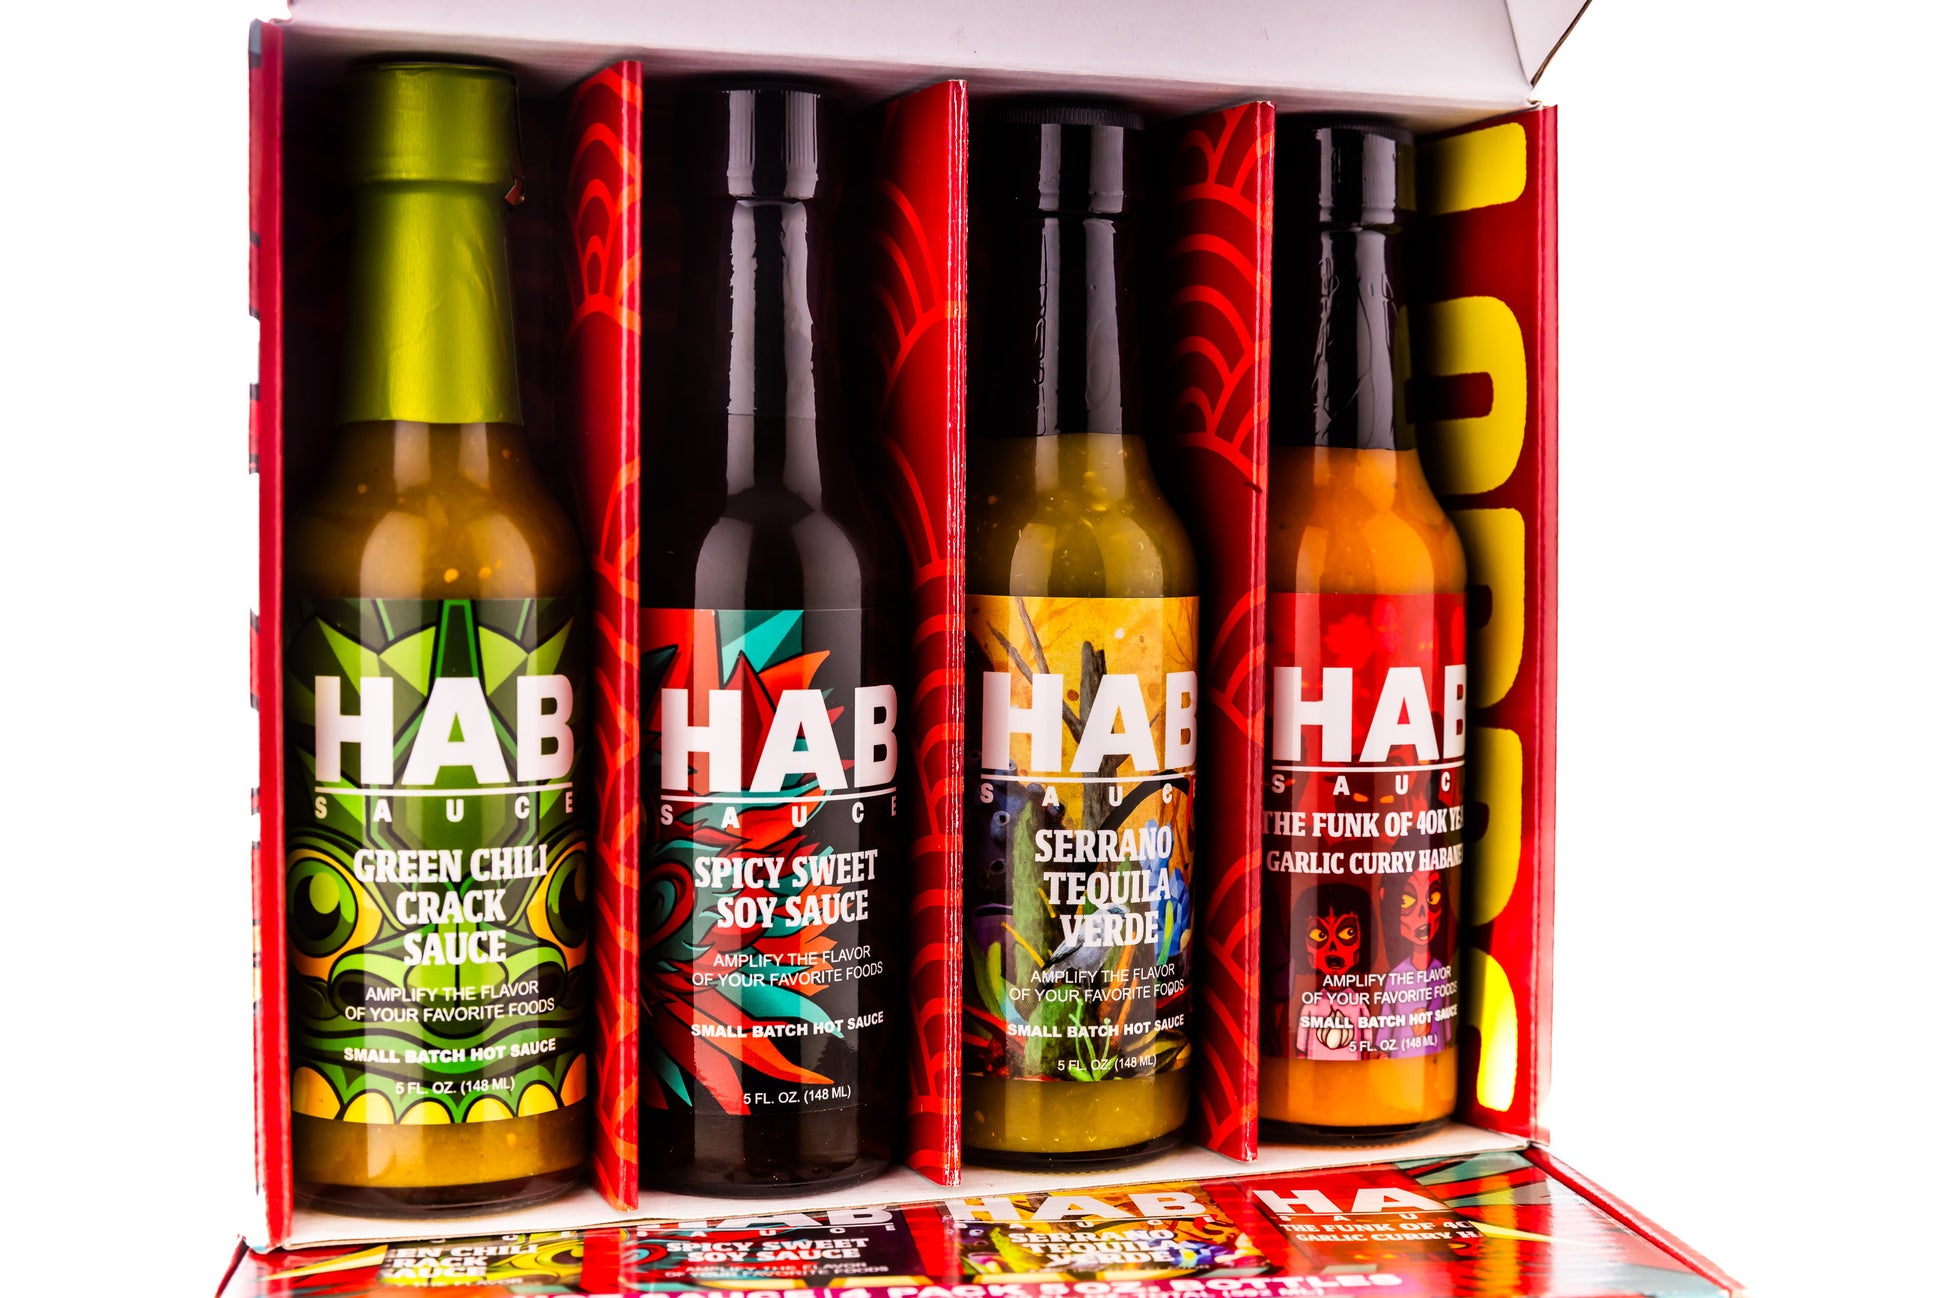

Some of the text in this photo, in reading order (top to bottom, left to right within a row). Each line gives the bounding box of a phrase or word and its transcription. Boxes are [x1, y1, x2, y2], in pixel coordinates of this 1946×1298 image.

[315, 674, 574, 785] HAB
[981, 670, 1198, 773] HAB
[661, 684, 898, 792] HAB
[315, 791, 573, 822] SAUCE
[980, 782, 1196, 807] SAUC
[661, 796, 896, 829] SAUCE
[1312, 812, 1380, 838] FUNK
[1385, 811, 1413, 837] OF
[1416, 808, 1448, 835] 40K
[1035, 825, 1172, 863] SERRANO
[353, 844, 548, 883] GREEN CHILI
[694, 849, 878, 888] SPICY SWEET
[1266, 851, 1344, 875] GARLIC
[1350, 851, 1416, 875] CURRY
[1043, 868, 1171, 906] TEQUILA
[396, 889, 507, 925] CRACK
[717, 889, 869, 928] SOY SAUCE
[1060, 911, 1159, 947] VERDE
[403, 930, 507, 967] SAUCE
[713, 945, 871, 968] AMPLIFY THE FLAVOR
[692, 961, 883, 987] OF YOUR FAVORITE FOODS
[1030, 963, 1175, 984] AMPLIFY THE FLAVOR
[1323, 965, 1452, 988] AMPLIFY THE FLAVOR
[365, 980, 539, 1002] AMPLIFY THE FLAVOR
[1009, 978, 1184, 1003] OF YOUR FAVORITE FOODS
[1302, 992, 1322, 1004] OF
[1326, 993, 1370, 1006] YOUR
[1374, 987, 1432, 1004] FAVORITE
[345, 998, 555, 1022] OF YOUR FAVORITE FOODS
[1300, 1004, 1458, 1029] SMALL BATCH HOT SAUCE
[690, 1010, 884, 1038] SMALL BATCH HOT SAUCE
[1007, 1013, 1185, 1038] SMALL BATCH HOT SAUCE
[344, 1038, 556, 1063] SMALL BATCH HOT SAUCE
[1350, 1041, 1357, 1051] 5
[1359, 1041, 1376, 1052] FL.
[1379, 1040, 1399, 1051] OZ.
[1401, 1038, 1421, 1052] (148
[1057, 1053, 1157, 1071] 5 FL. OZ. (148 ML)
[395, 1076, 515, 1096] 5 FL. OZ. (148 ML)
[743, 1085, 851, 1105] 5 FL. OZ. (148 ML)
[945, 1192, 1207, 1221] HAB
[1009, 1230, 1175, 1243] SERRANO
[1280, 1224, 1320, 1232] THE
[1323, 1223, 1397, 1232] FUNK
[1400, 1222, 1436, 1231] OF
[1296, 1233, 1369, 1242] GARLIC
[1370, 1232, 1453, 1241] CURRY
[450, 1244, 538, 1257] CHILI
[666, 1237, 869, 1252] SPICY SWEET
[687, 1247, 861, 1263] SOY SAUCE
[1023, 1240, 1183, 1254] TEQUILA
[1047, 1251, 1176, 1265] VERDE
[887, 1284, 1023, 1298] PACK
[1170, 1273, 1403, 1291] BOTTLES
